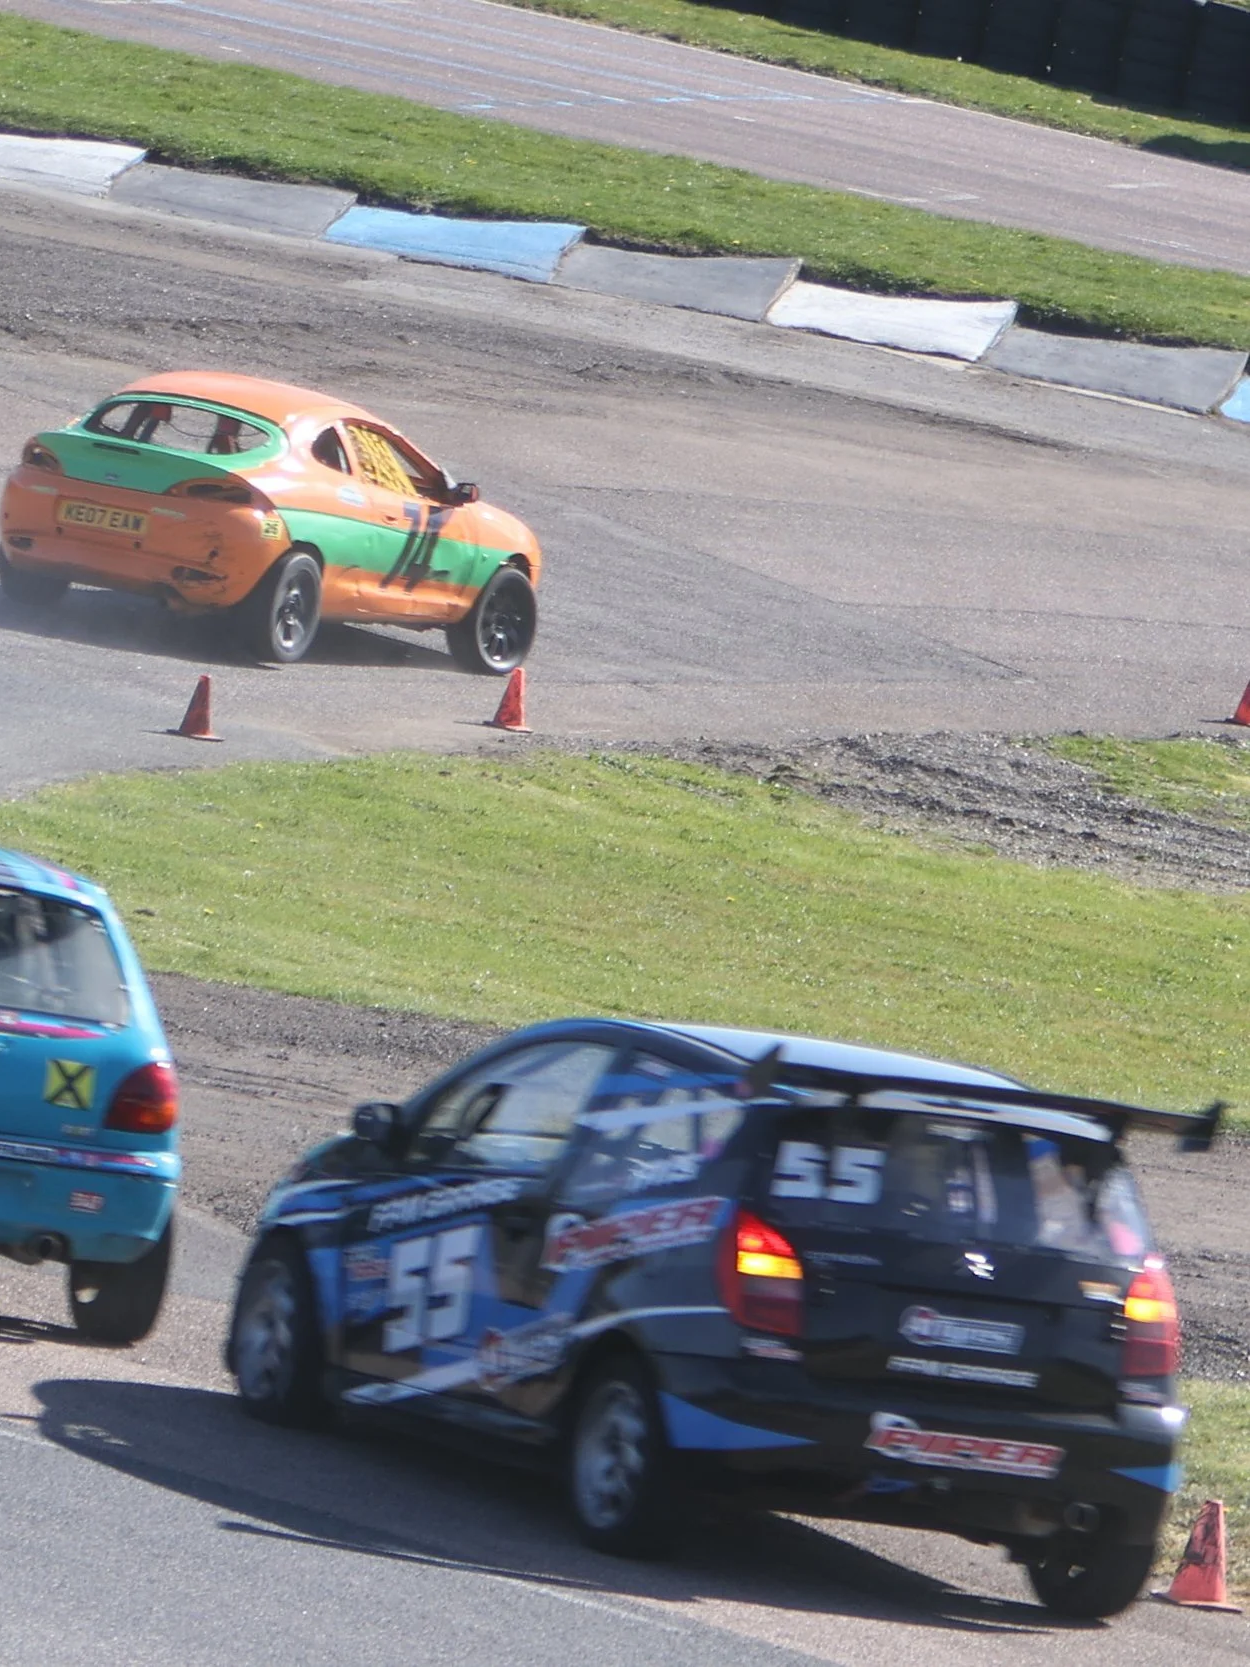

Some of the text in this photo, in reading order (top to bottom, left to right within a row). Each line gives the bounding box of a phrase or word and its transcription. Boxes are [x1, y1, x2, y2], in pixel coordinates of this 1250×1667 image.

[65, 501, 107, 523] KE07
[769, 1140, 886, 1204] 55
[381, 1224, 484, 1353] 55
[875, 1426, 1064, 1468] PIPER
